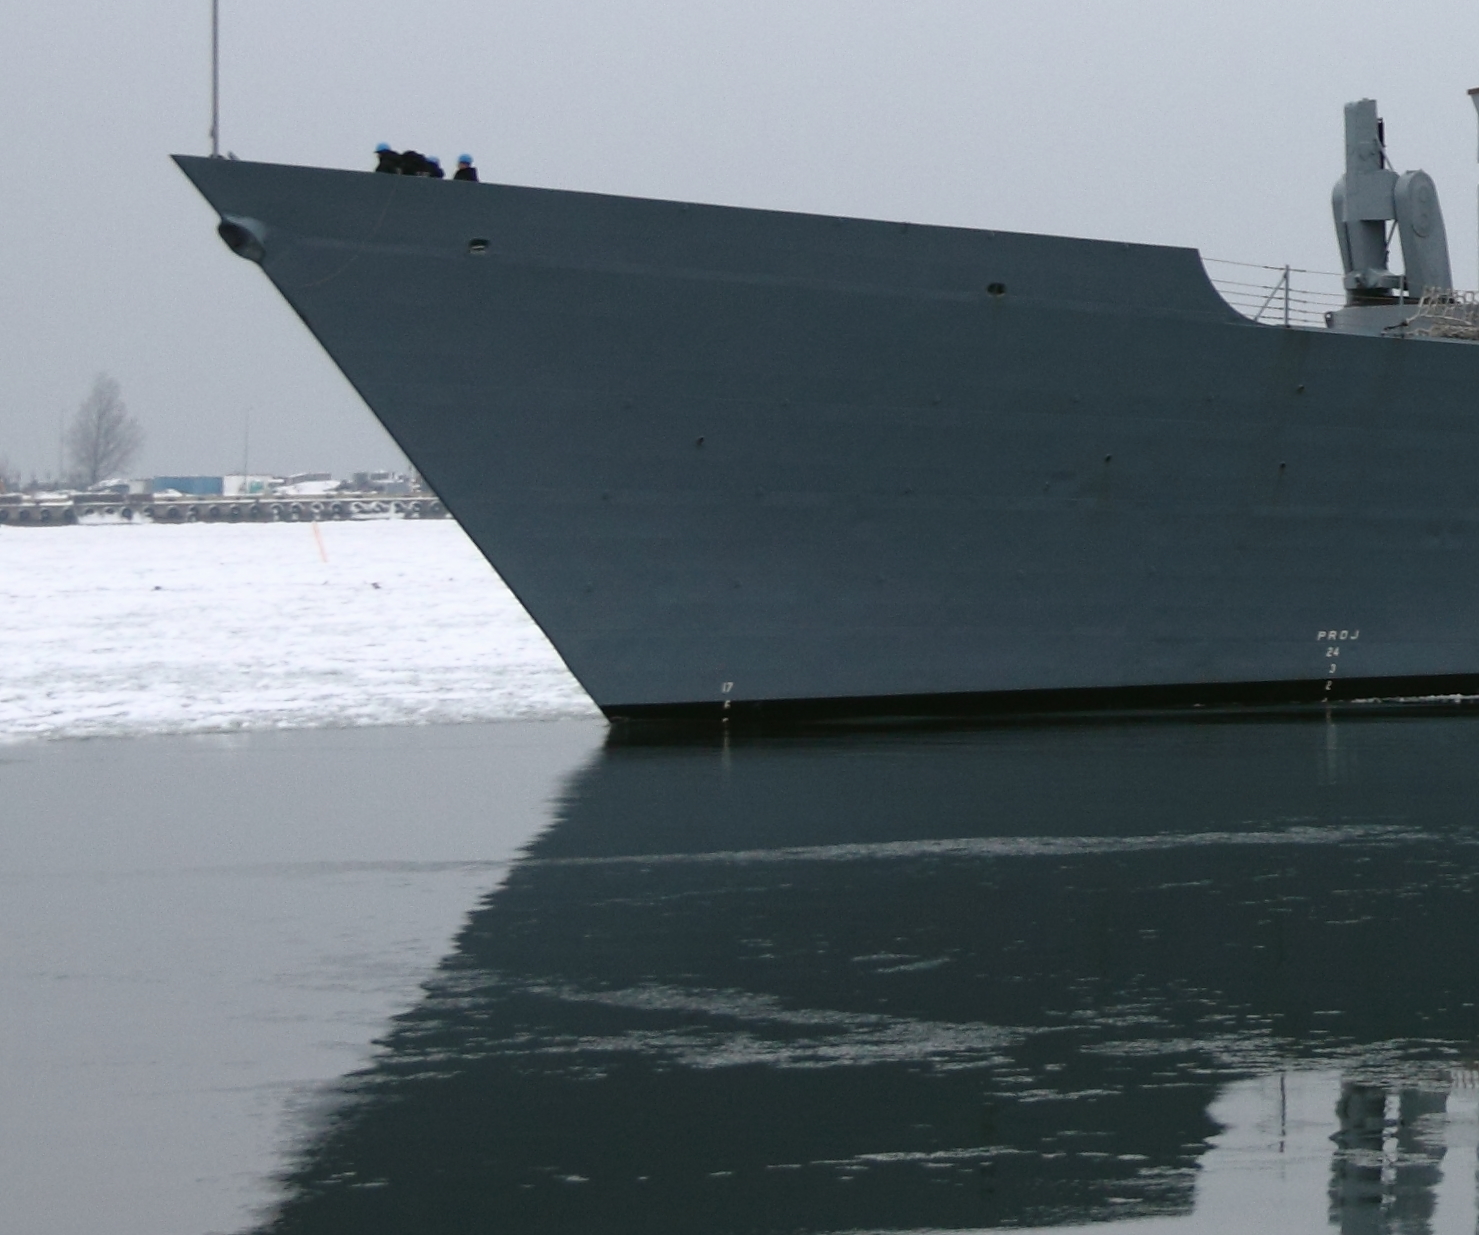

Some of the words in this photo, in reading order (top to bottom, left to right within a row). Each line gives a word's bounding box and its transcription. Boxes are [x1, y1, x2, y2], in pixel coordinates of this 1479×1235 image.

[1317, 630, 1360, 640] PROJ
[1326, 647, 1339, 657] 24
[723, 682, 734, 692] 17
